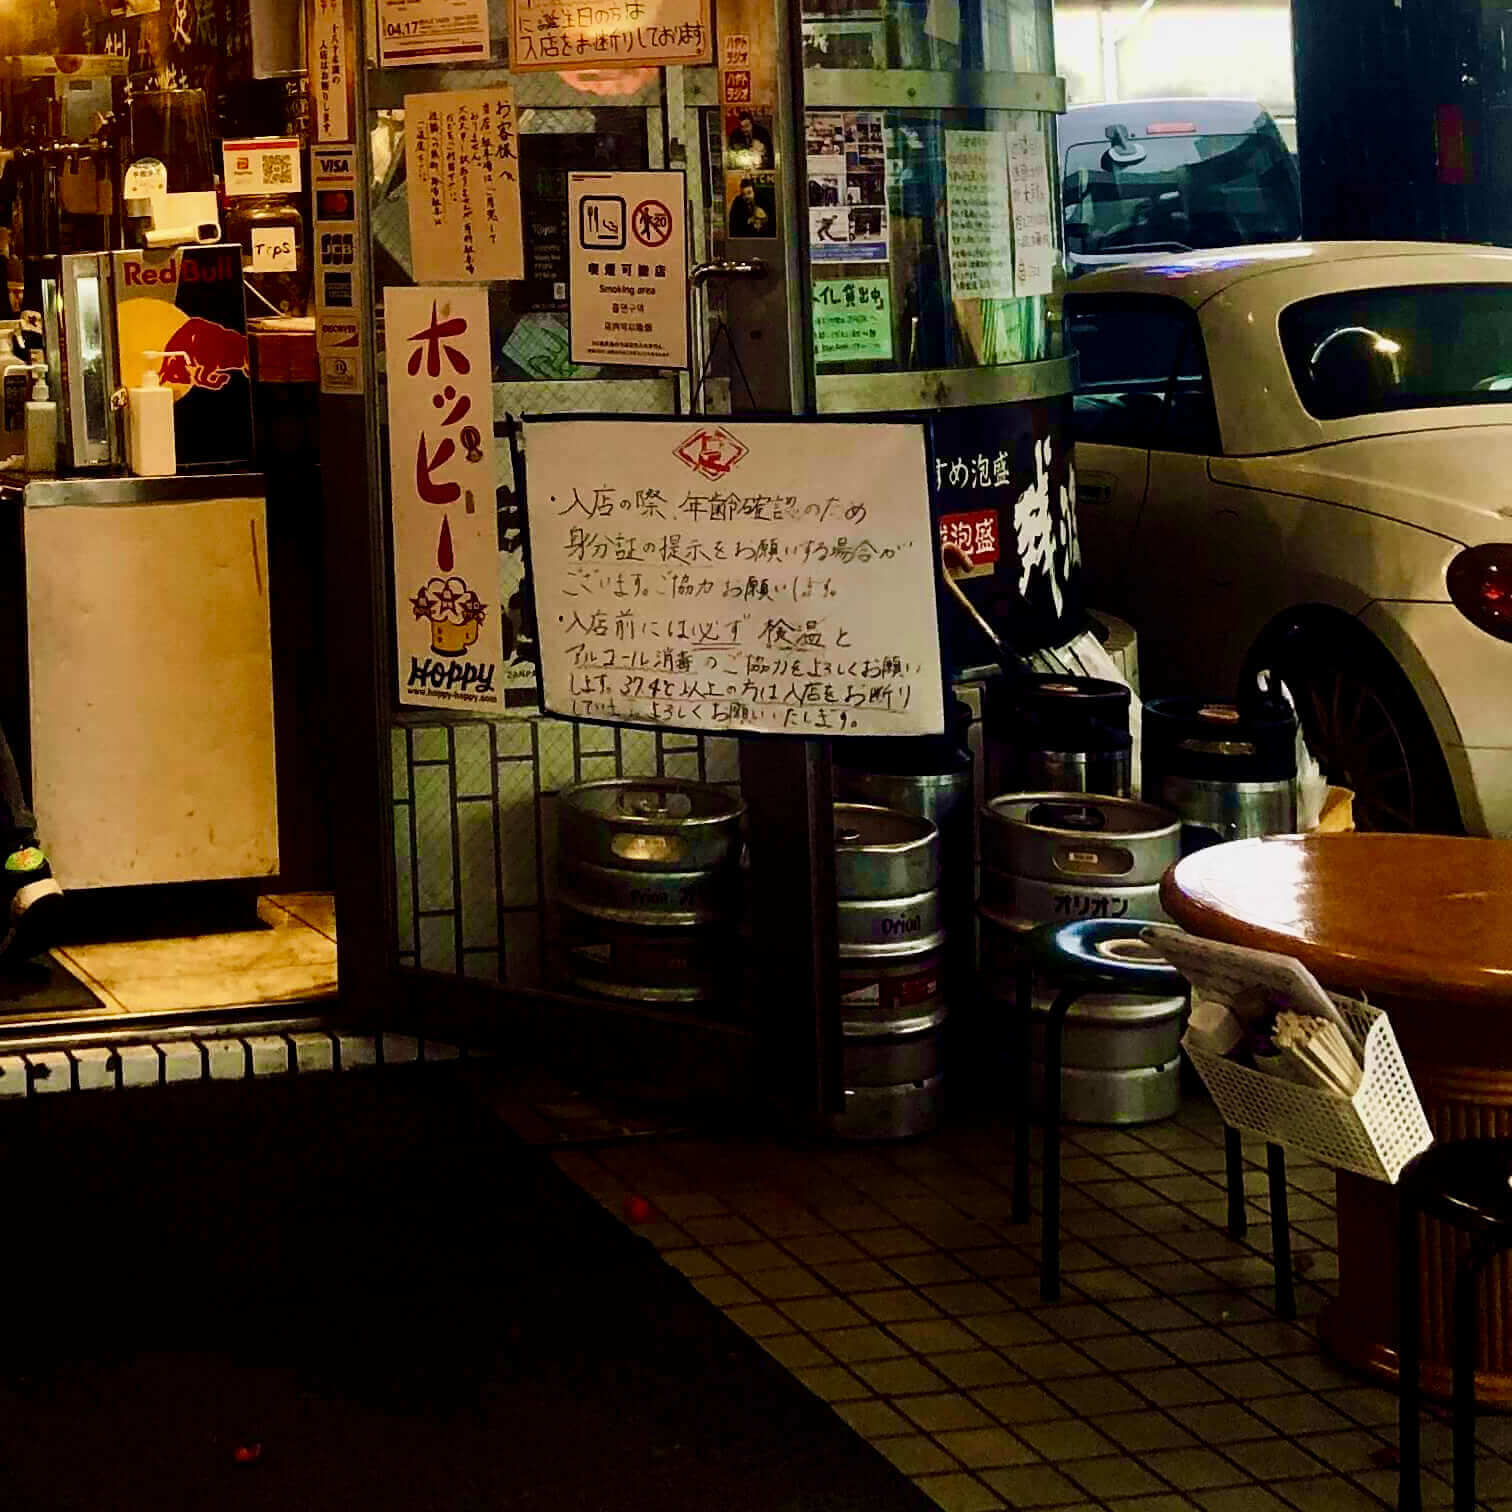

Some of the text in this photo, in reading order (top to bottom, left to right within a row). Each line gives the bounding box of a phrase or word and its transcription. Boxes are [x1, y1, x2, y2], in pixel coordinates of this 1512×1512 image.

[319, 158, 350, 174] VISA
[122, 255, 233, 287] Red Bull
[587, 262, 667, 278] 喫煙可能店
[599, 284, 656, 297] Smoking area
[406, 298, 483, 573] ホッピー
[1053, 893, 1130, 917] オリオン
[881, 913, 922, 936] Orion
